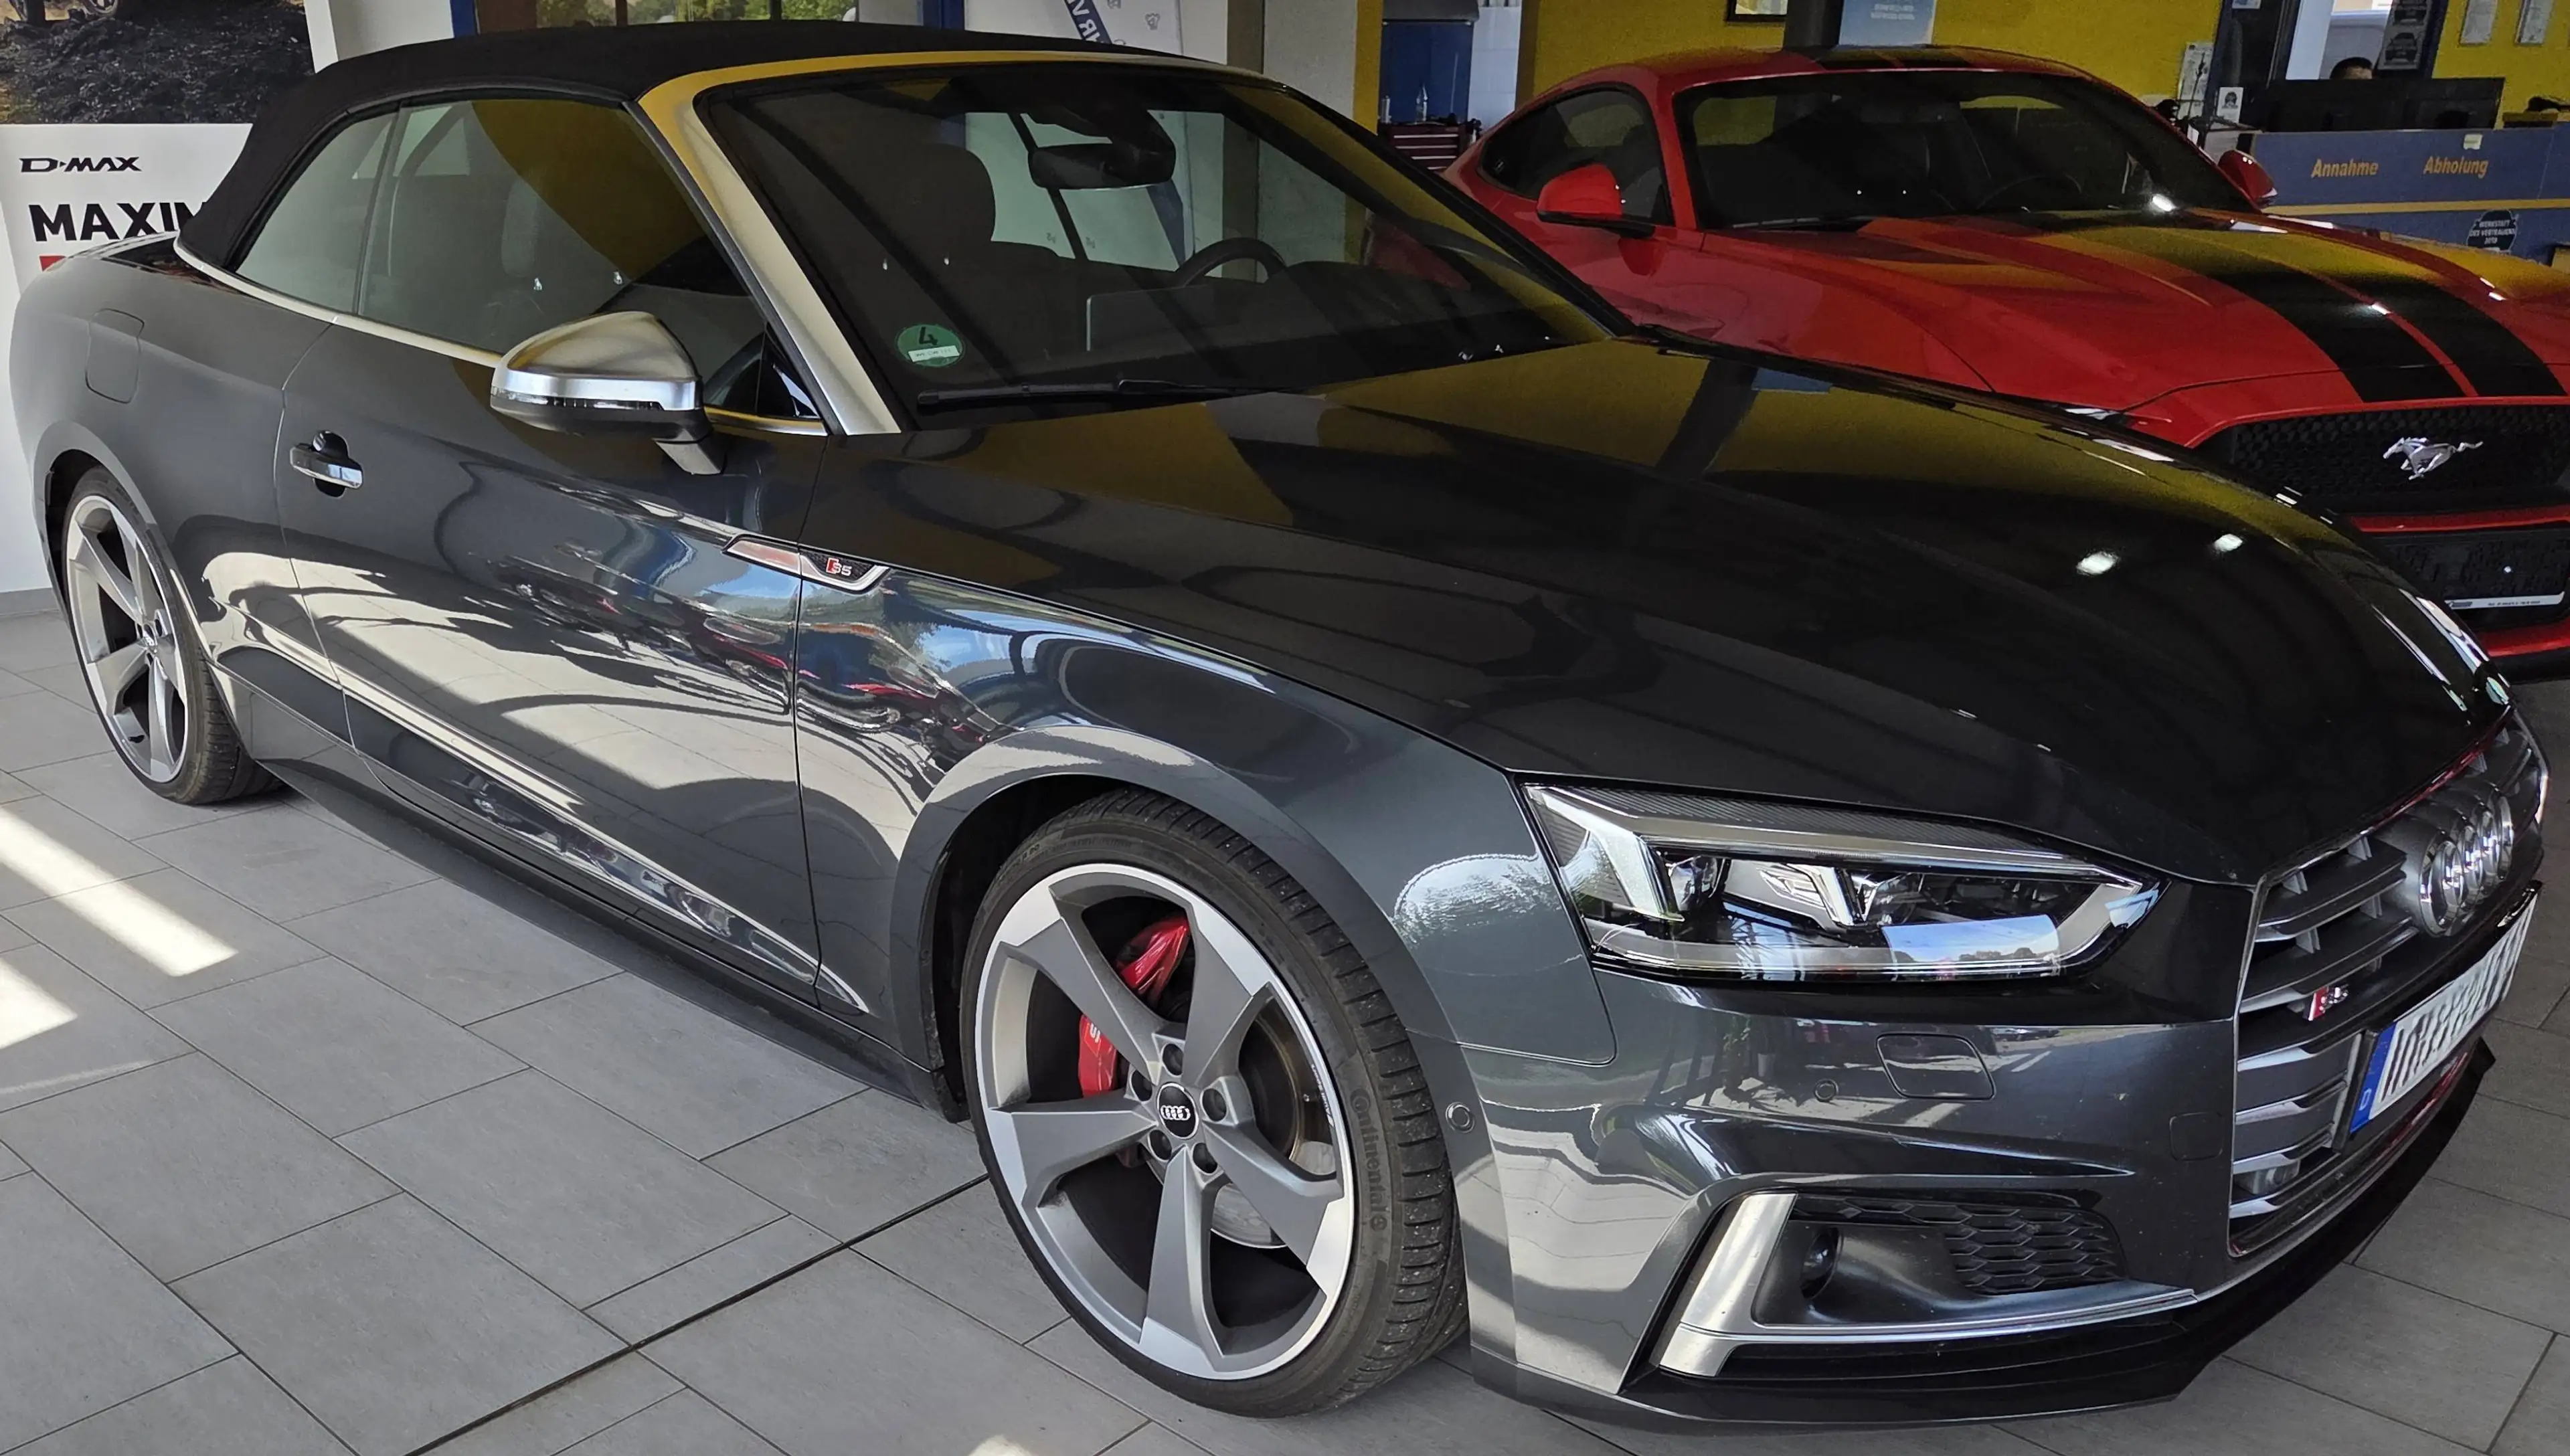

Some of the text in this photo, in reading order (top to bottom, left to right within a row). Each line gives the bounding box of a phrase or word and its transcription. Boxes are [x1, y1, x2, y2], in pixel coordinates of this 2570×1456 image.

[2311, 159, 2378, 178] Annahme
[2423, 155, 2488, 179] Abholung
[919, 326, 938, 345] 4
[830, 561, 852, 576] S5
[1350, 1088, 1389, 1212] Continental
